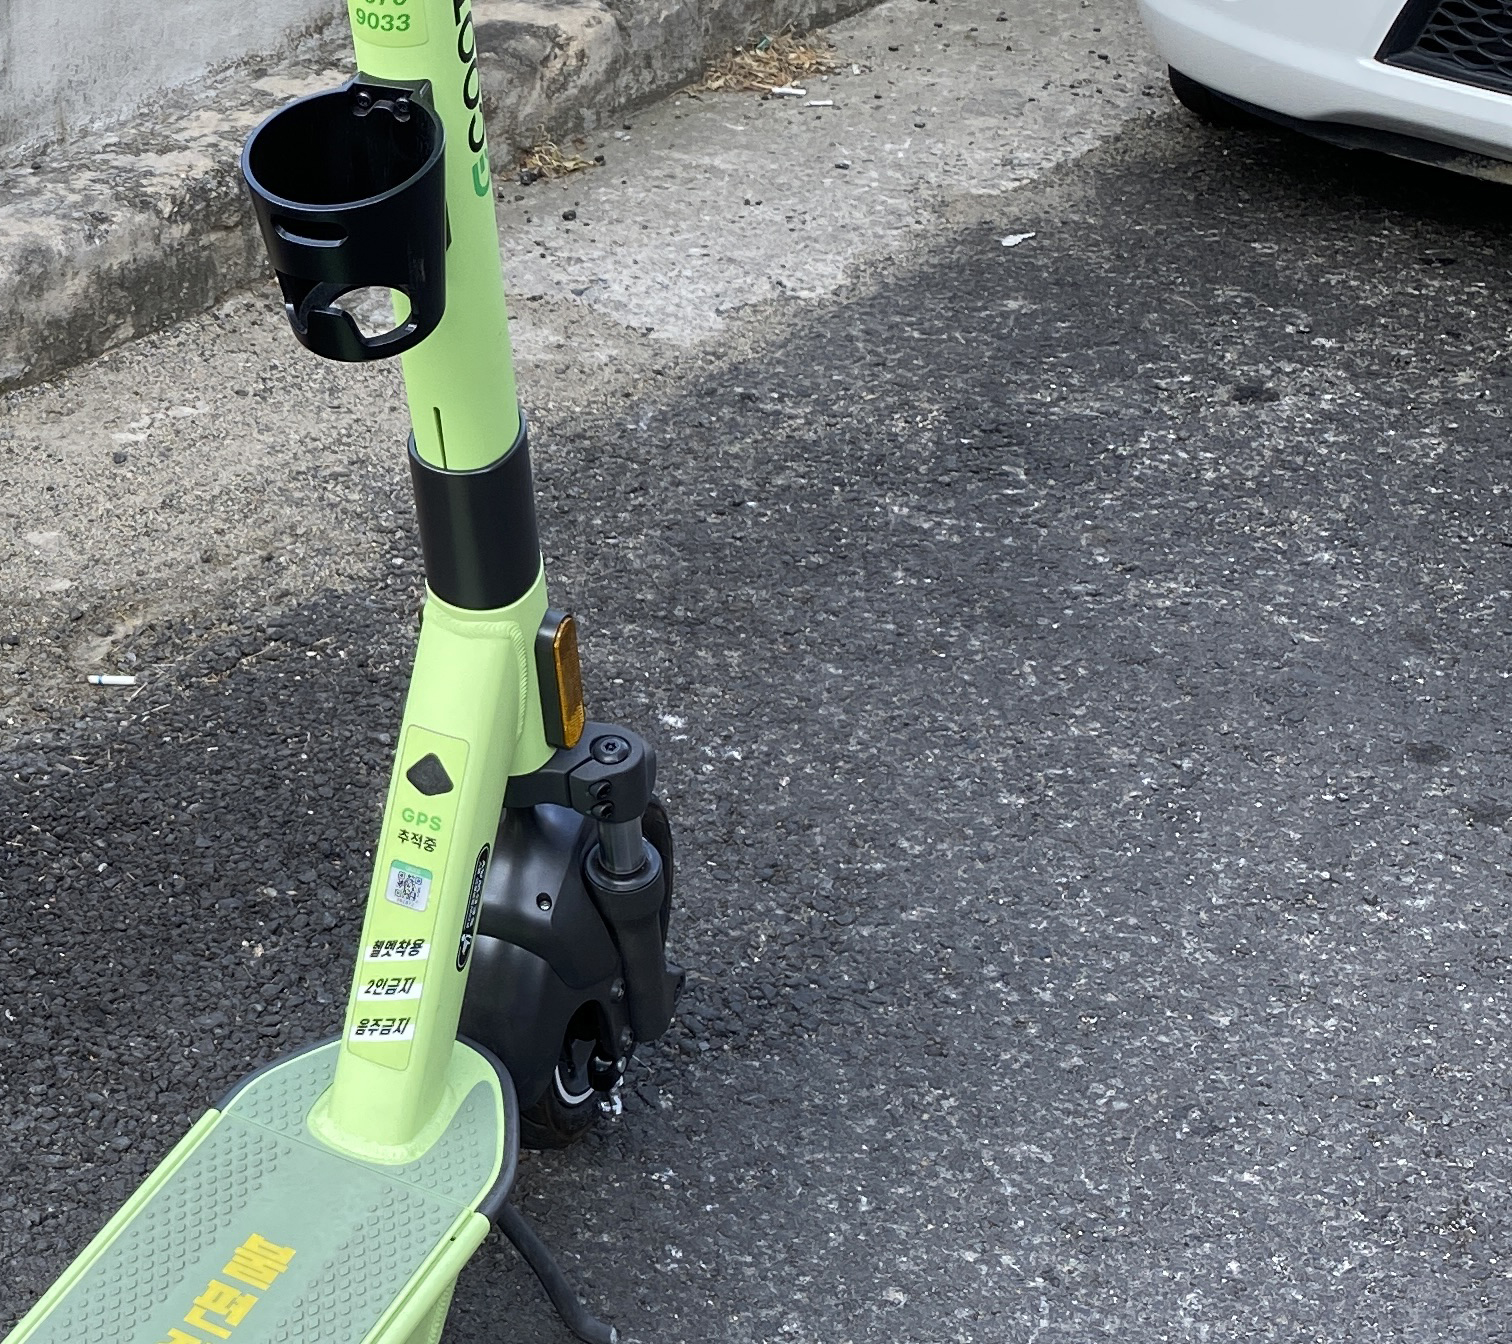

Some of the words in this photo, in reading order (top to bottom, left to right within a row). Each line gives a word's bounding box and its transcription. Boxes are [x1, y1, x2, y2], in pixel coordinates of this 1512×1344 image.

[355, 7, 411, 33] 9033
[401, 807, 442, 832] GPS
[396, 828, 437, 853] 추적중
[369, 938, 425, 959] 헬멧착용
[364, 976, 416, 996] 2인금지
[355, 1017, 411, 1037] 음주금지
